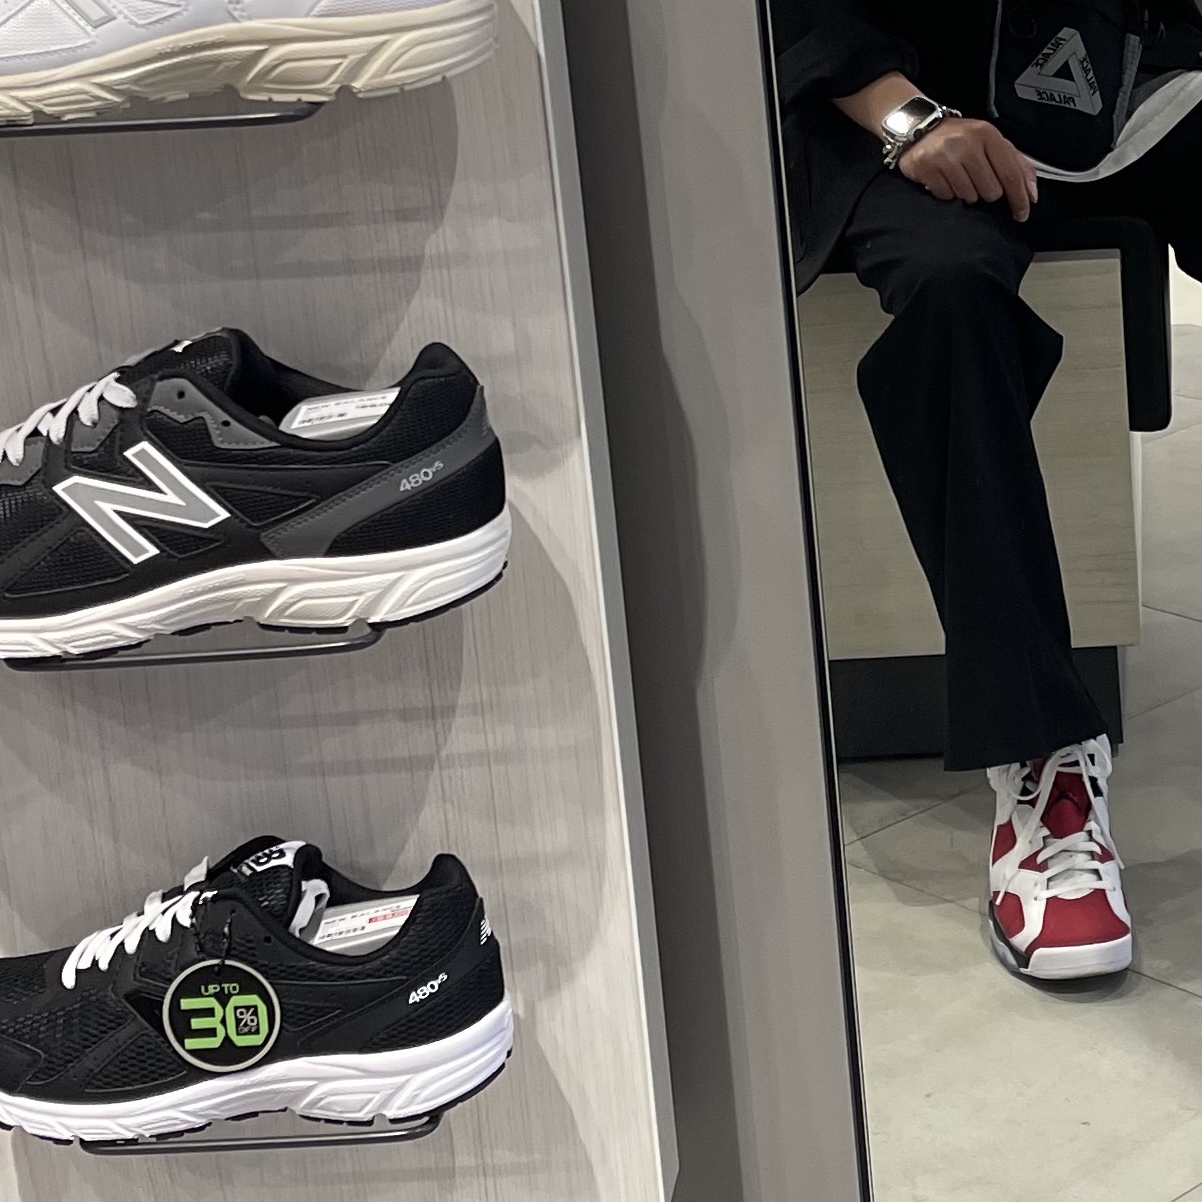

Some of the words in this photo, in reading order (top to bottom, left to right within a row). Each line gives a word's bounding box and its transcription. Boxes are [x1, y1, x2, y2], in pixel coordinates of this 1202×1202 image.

[200, 984, 220, 996] UP
[221, 982, 240, 995] TO
[180, 994, 269, 1050] 30
